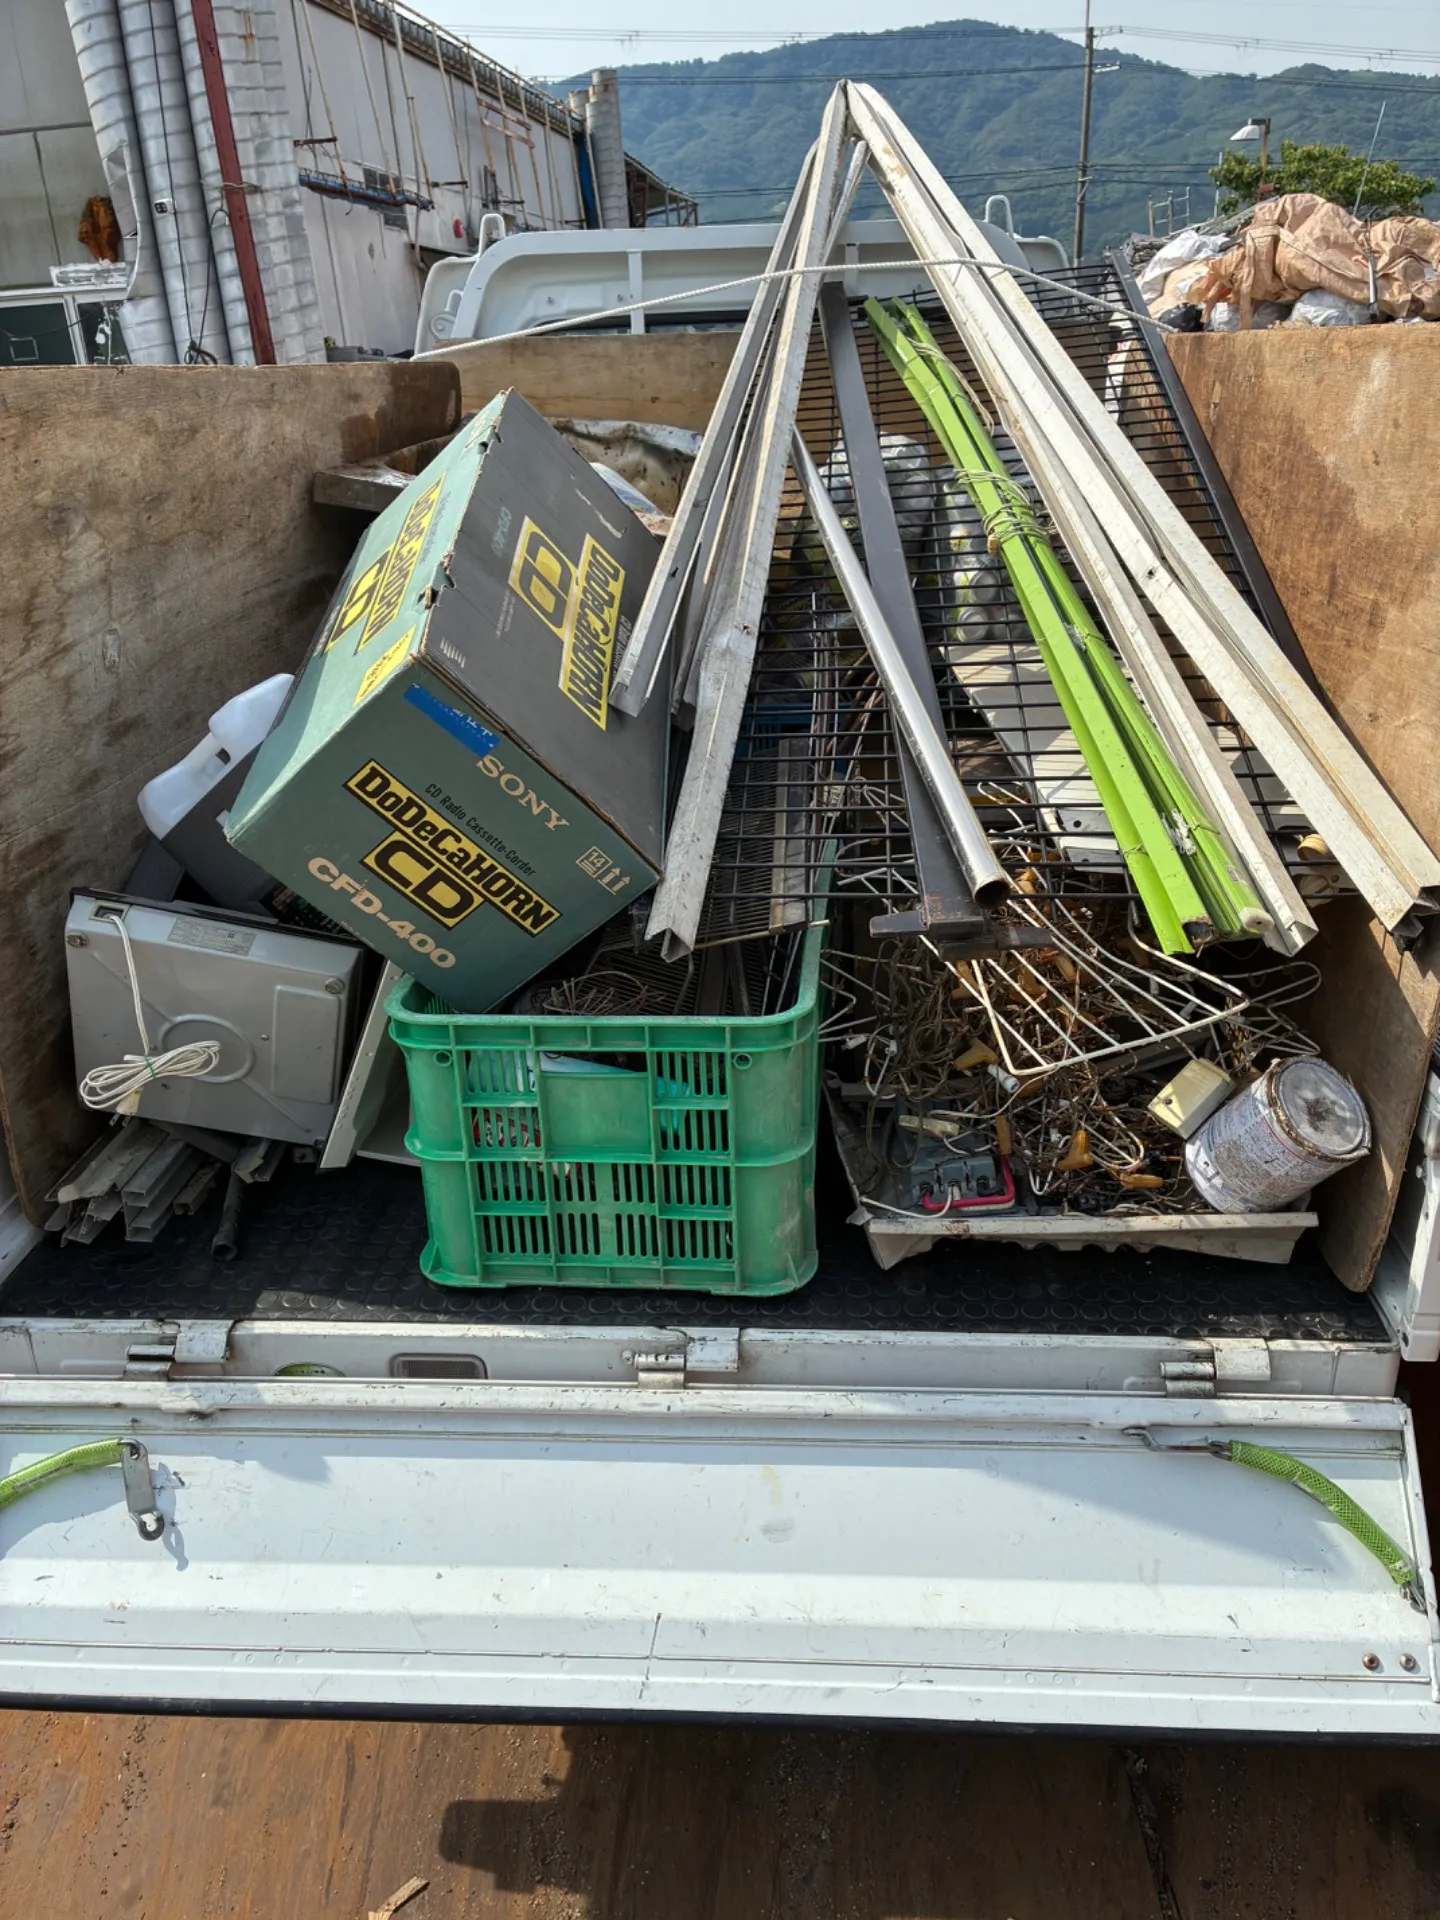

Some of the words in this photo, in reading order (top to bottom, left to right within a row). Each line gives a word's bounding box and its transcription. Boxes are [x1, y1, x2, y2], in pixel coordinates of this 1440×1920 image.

[330, 550, 389, 643] CD
[518, 529, 574, 621] CD
[566, 543, 620, 719] DoDeCaHORN
[425, 783, 442, 799] CD
[439, 795, 467, 820] Radio
[465, 817, 536, 877] Cassette-Corder
[475, 754, 570, 831] SONY
[353, 765, 553, 932] DoDeCaHORN
[373, 839, 476, 921] CD
[306, 856, 457, 969] CFD-400
